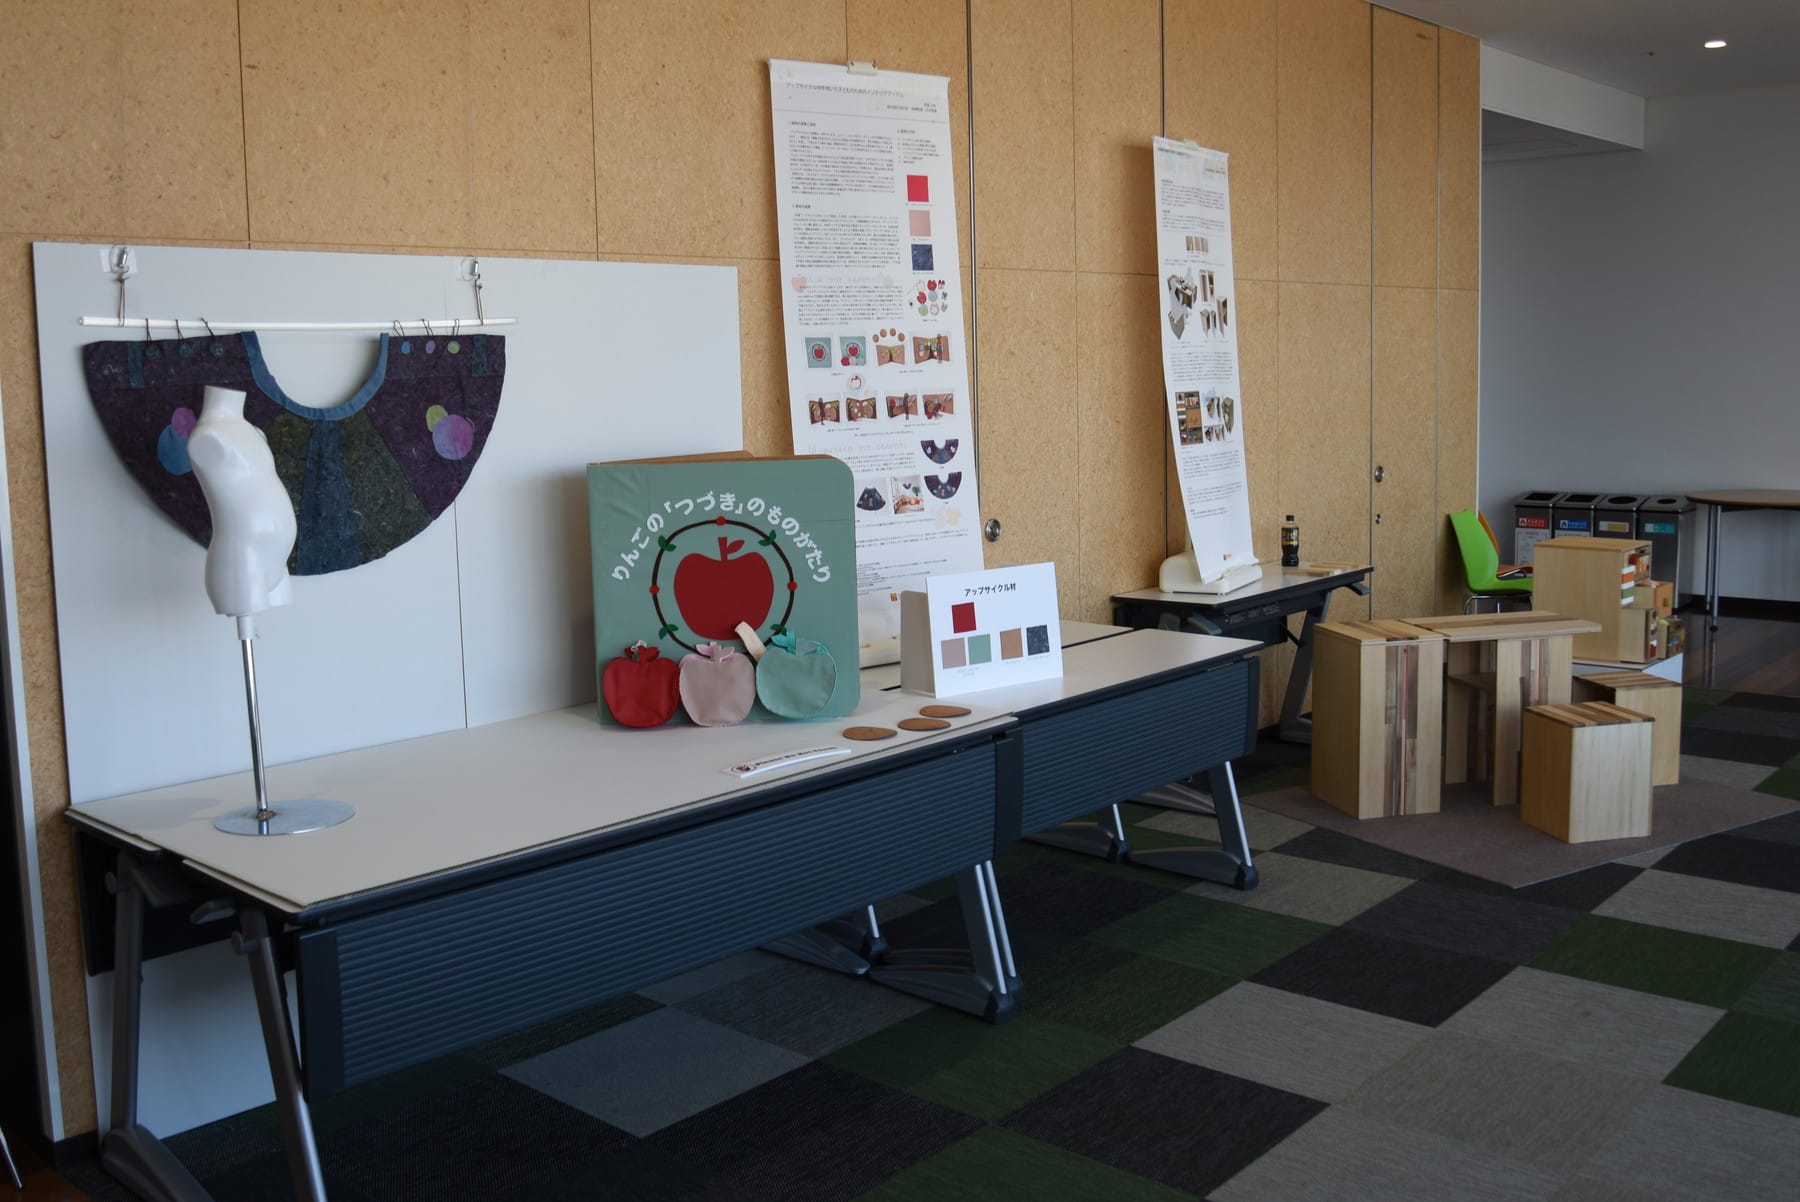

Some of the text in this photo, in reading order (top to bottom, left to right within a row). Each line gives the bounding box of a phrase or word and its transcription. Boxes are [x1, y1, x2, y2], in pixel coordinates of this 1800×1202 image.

[611, 491, 831, 583] りんごの「つづき」のものがたり
